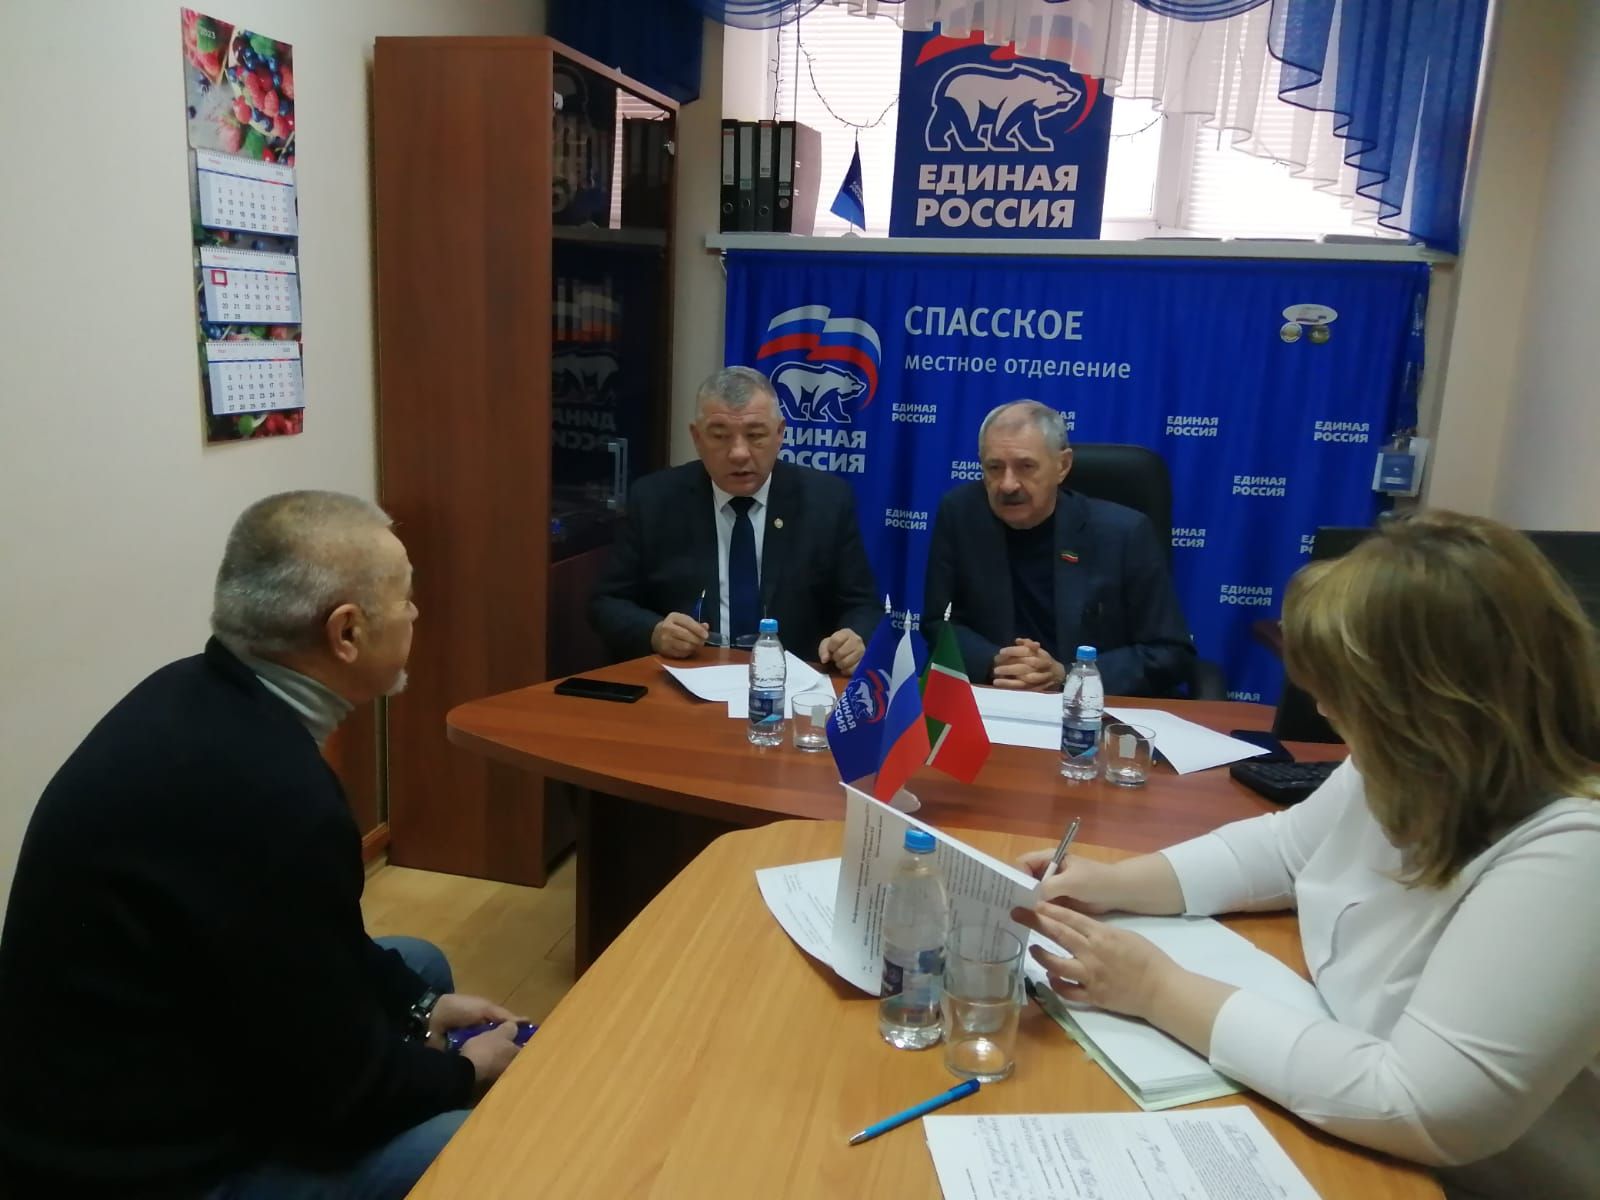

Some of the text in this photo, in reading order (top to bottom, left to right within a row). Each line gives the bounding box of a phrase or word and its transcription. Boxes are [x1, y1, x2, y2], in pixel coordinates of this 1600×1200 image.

[918, 164, 1079, 195] ЕДИНАЯ
[916, 197, 1075, 228] РОССИЯ
[904, 305, 1085, 341] СПАССКОЕ
[905, 354, 1131, 379] местное отделение
[891, 402, 937, 413] ЕДИНАЯ
[891, 412, 937, 424] РОССИЯ
[1166, 415, 1219, 426] ЕДИНАЯ
[1165, 426, 1218, 437] РОССИЯ
[1314, 420, 1370, 432] ЕДИНАЯ
[782, 426, 867, 449] ДИНАЯ
[1313, 432, 1369, 443] РОССИЯ
[777, 449, 866, 473] ОССИЯ
[951, 460, 983, 470] ЕДИН
[950, 470, 984, 481] РОСС
[1233, 475, 1287, 486] ЕДИНАЯ
[1232, 486, 1286, 497] РОССИЯ
[885, 508, 928, 520] ЕДИНАЯ
[885, 518, 927, 531] РОССИЯ
[1171, 527, 1206, 537] ИНАЯ
[1171, 537, 1205, 548] ССИЯ
[1220, 584, 1273, 596] ЕДИНАЯ
[1219, 595, 1272, 607] РОССИЯ
[1226, 690, 1261, 701] ИНАЯ
[841, 692, 857, 729] ИНАЯ
